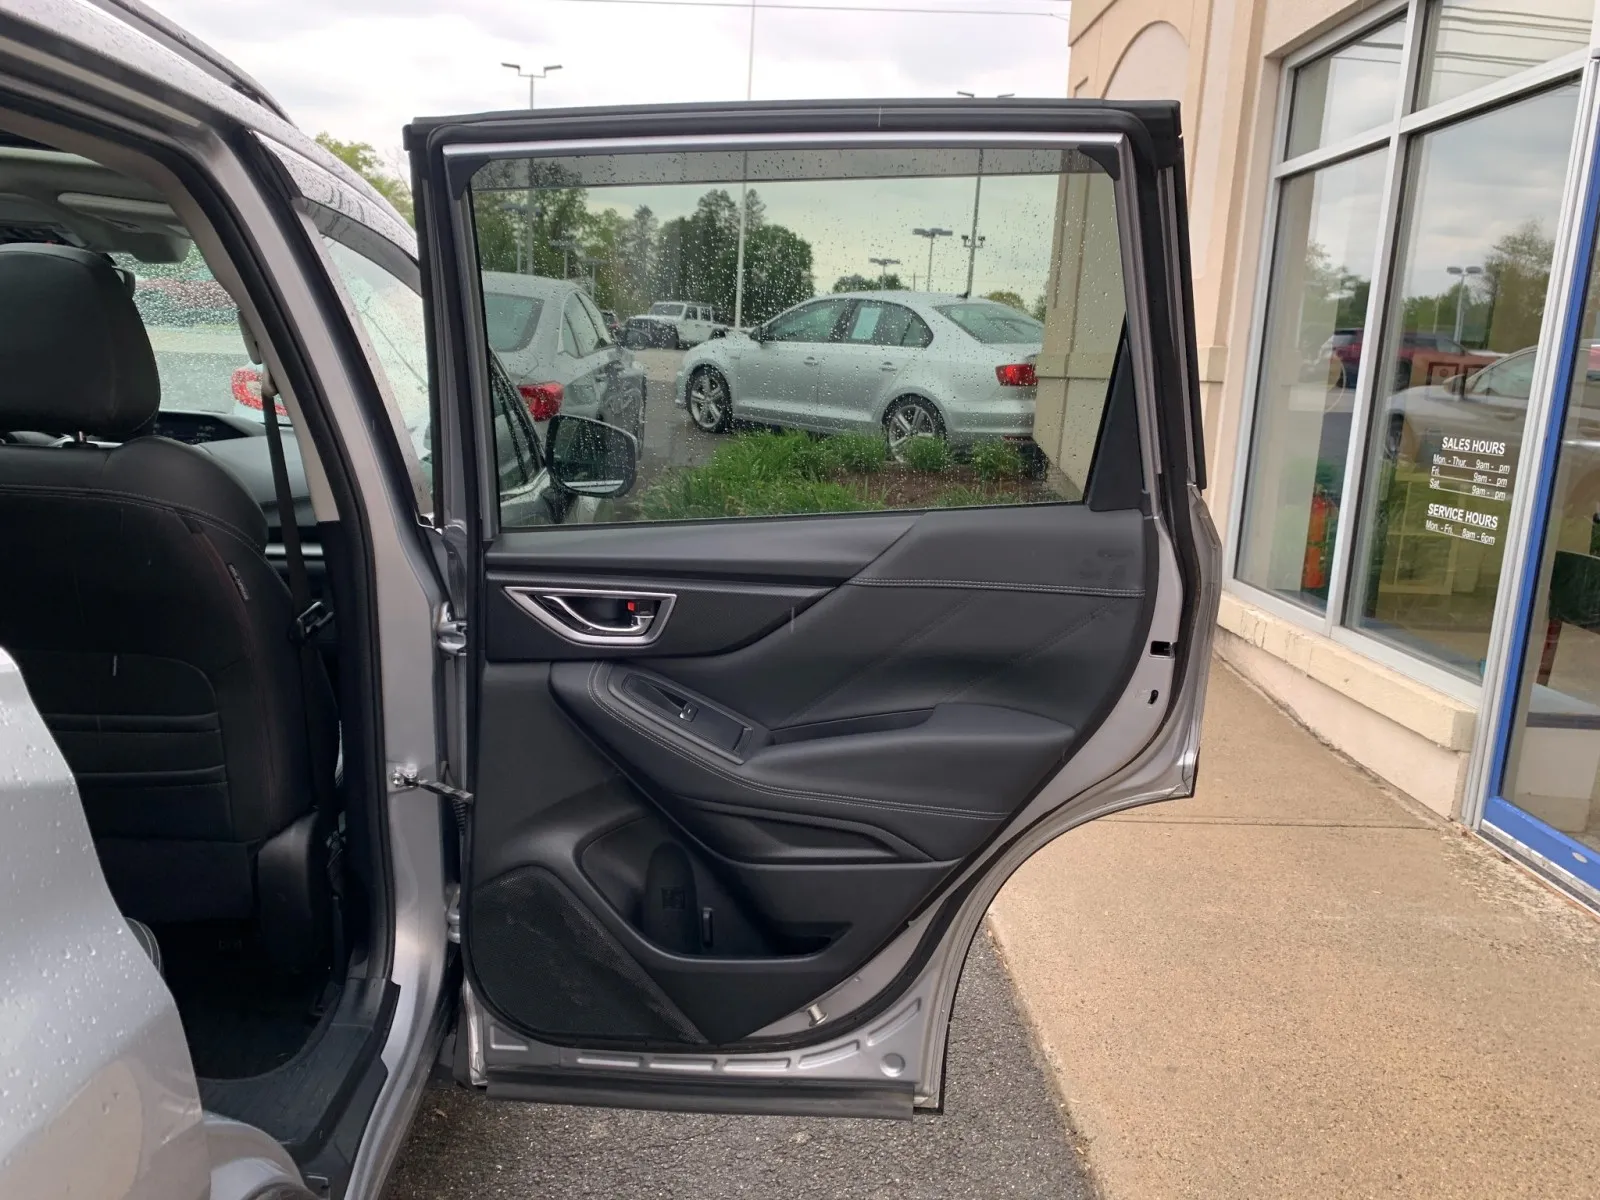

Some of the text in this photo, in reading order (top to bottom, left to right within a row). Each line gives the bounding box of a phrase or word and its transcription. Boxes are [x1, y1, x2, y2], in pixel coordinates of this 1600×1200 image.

[1442, 436, 1506, 455] SALES HOURS
[1427, 503, 1498, 528] SERVICE HOURS
